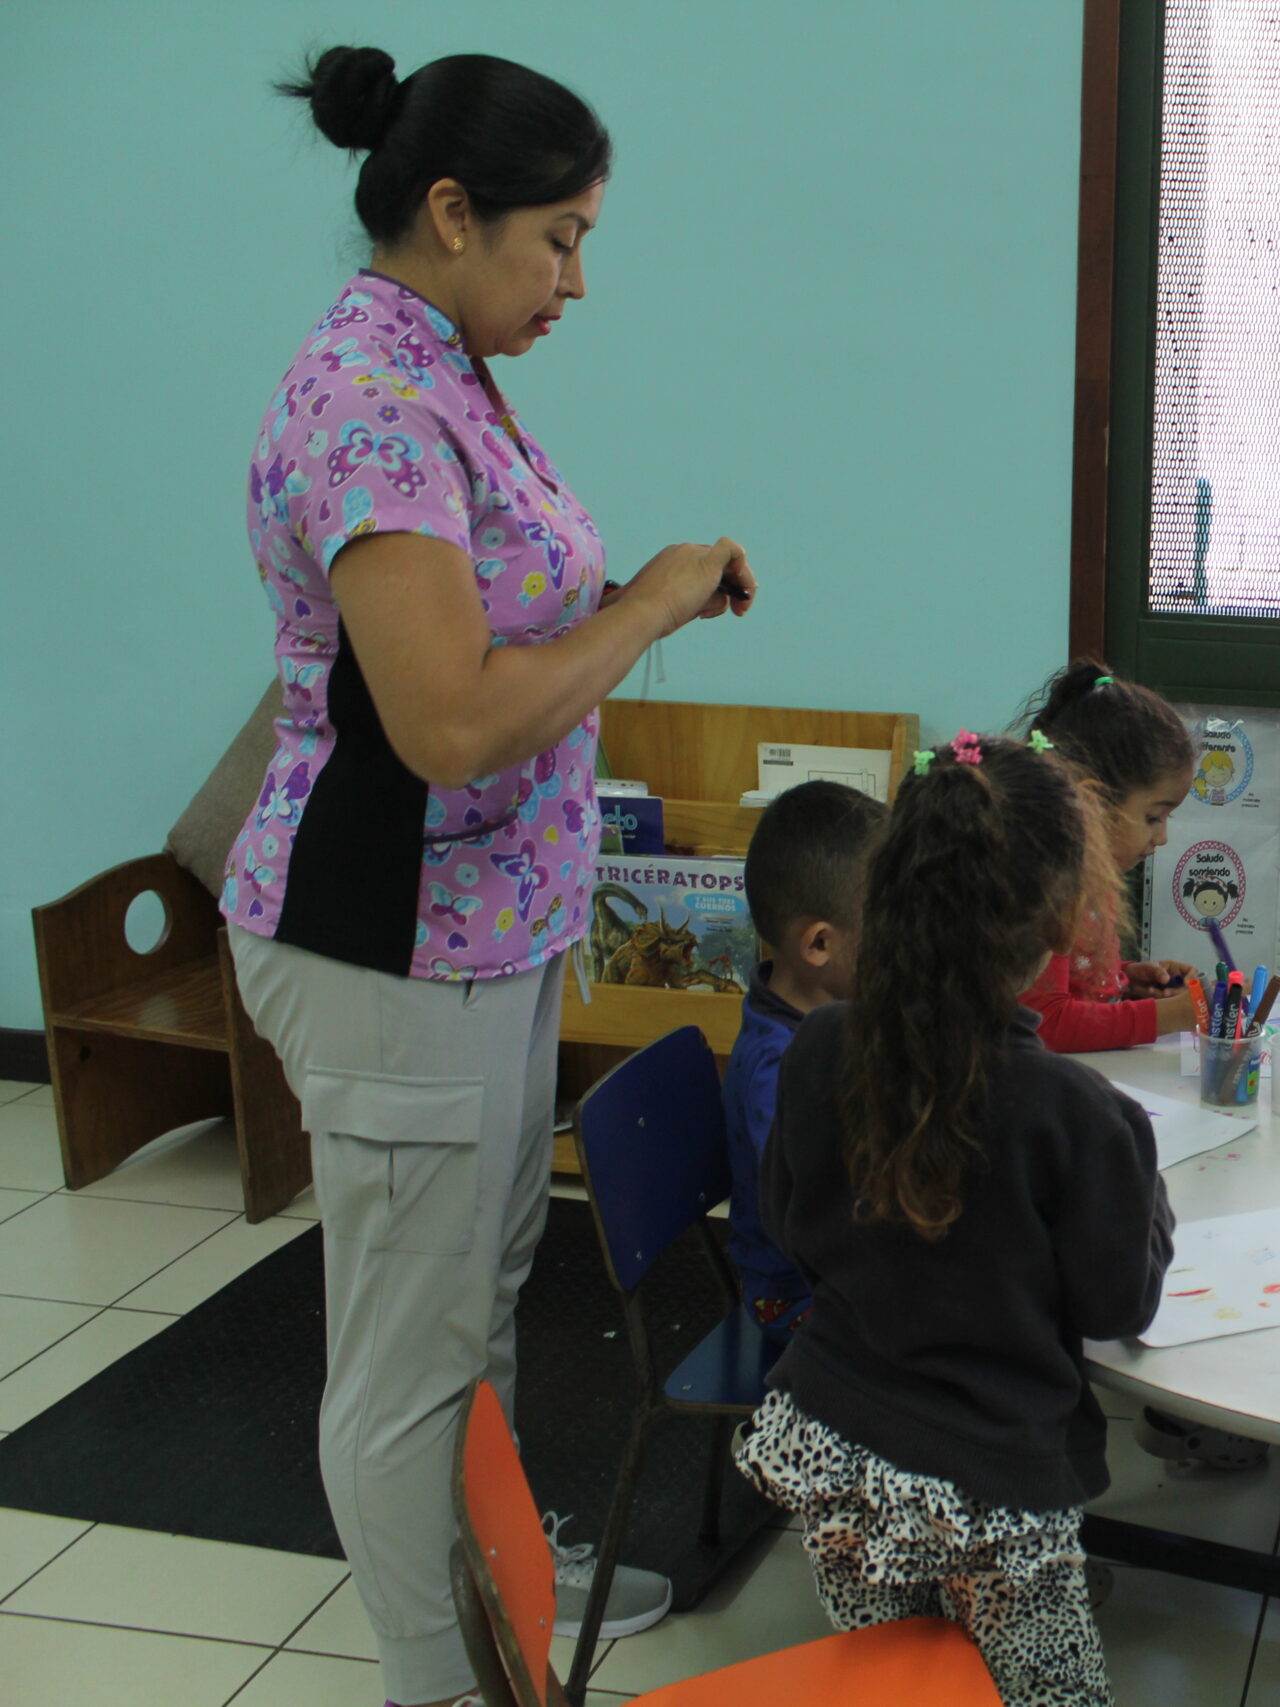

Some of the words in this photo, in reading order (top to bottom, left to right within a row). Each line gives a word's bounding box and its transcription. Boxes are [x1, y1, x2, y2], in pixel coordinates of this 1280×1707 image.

[1202, 730, 1232, 740] Saludo
[1196, 853, 1225, 863] Saludo
[595, 863, 745, 892] TRICÉRATOPS
[695, 903, 736, 912] CUERNOS
